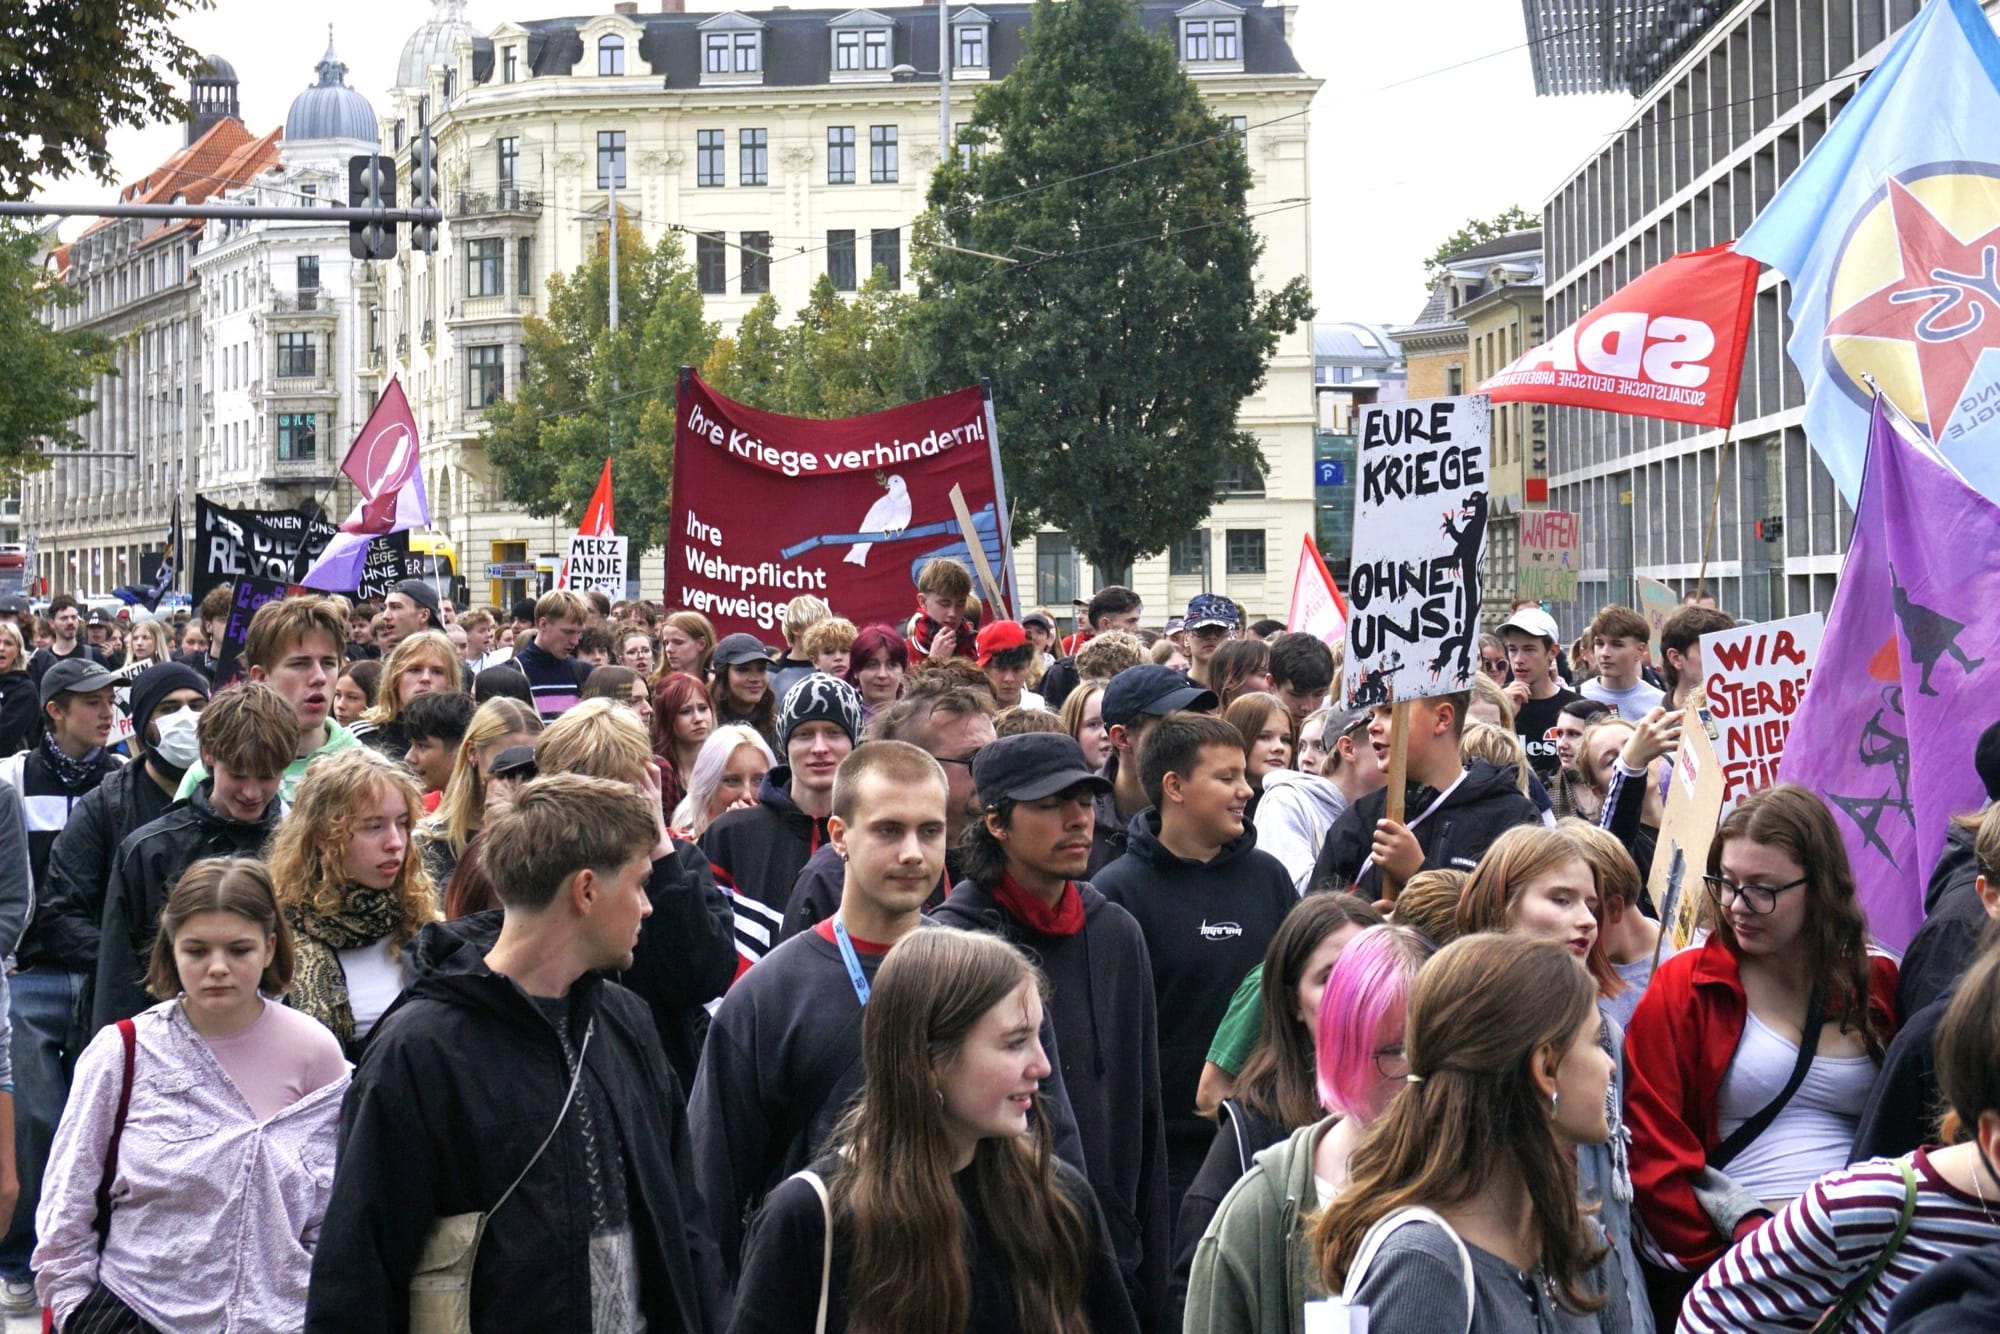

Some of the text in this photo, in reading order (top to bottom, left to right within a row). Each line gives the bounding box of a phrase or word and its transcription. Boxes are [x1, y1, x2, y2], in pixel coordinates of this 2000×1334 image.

[688, 403, 986, 477] Ihre Kriege verhindern!
[1362, 402, 1455, 451] EURE
[571, 539, 619, 556] MERZ
[686, 509, 723, 547] Ihre
[1520, 512, 1580, 551] WAFFEN
[362, 564, 399, 581] HNE
[570, 558, 622, 575] AN DIE
[685, 545, 827, 591] Wehrpflicht
[1350, 555, 1454, 603] OHNE
[1351, 587, 1463, 660] UNS!
[1712, 630, 1807, 672] WIR
